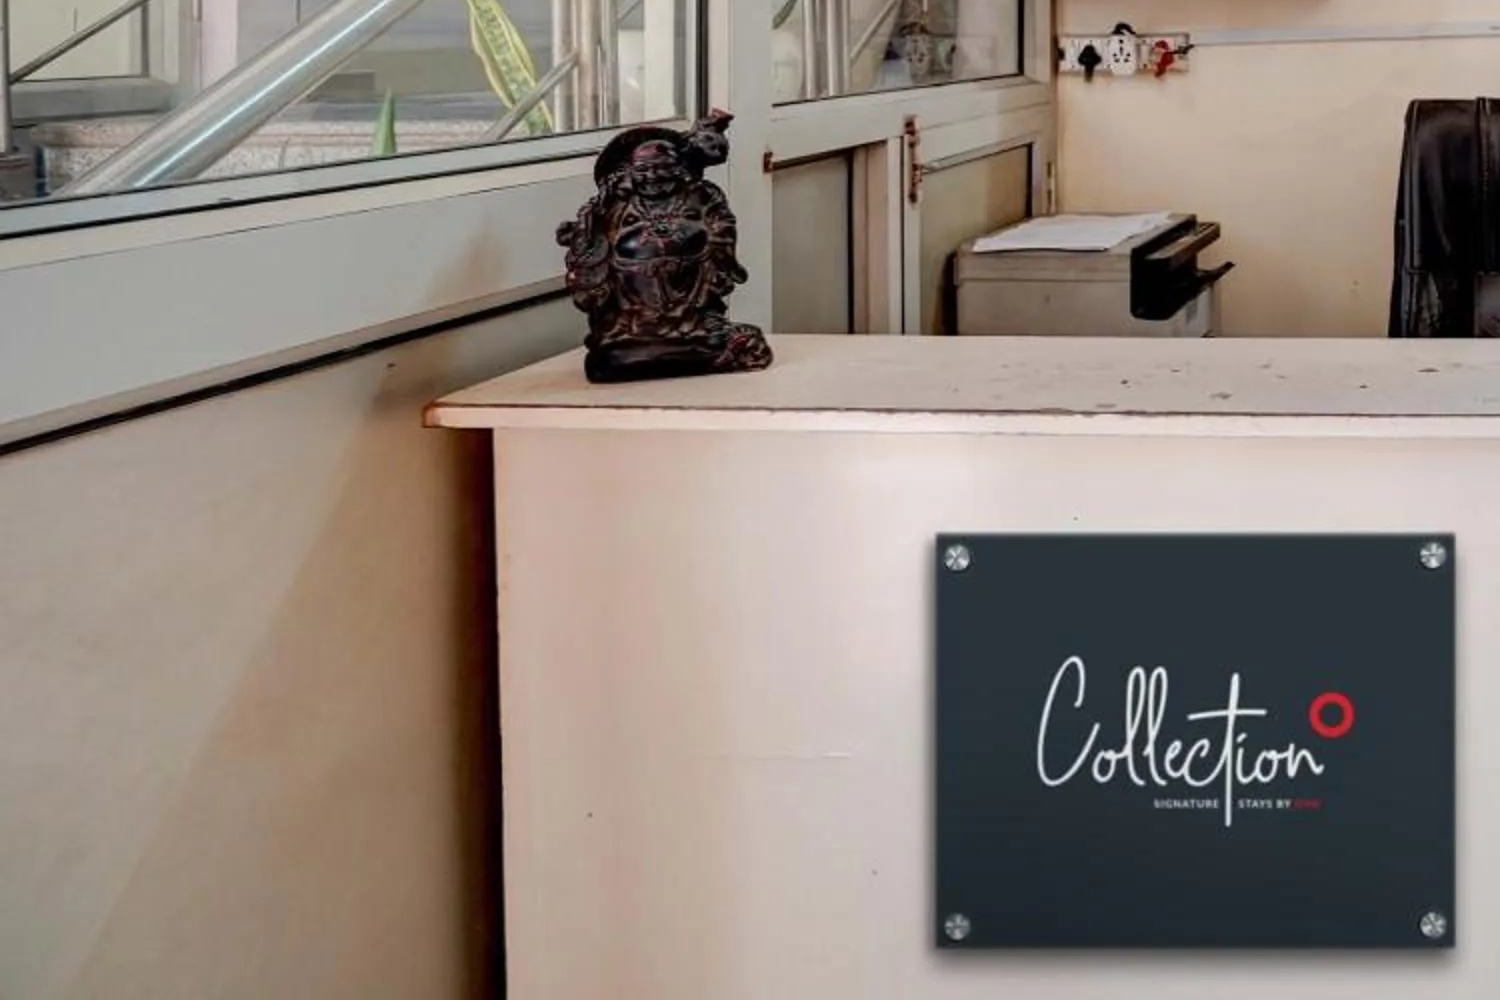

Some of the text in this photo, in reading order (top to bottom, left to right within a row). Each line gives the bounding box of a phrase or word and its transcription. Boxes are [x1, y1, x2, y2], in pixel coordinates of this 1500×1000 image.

[1036, 655, 1325, 827] Collection
[1153, 798, 1219, 809] SIGNATURE
[1238, 798, 1273, 809] STAYS
[1276, 798, 1291, 809] BY
